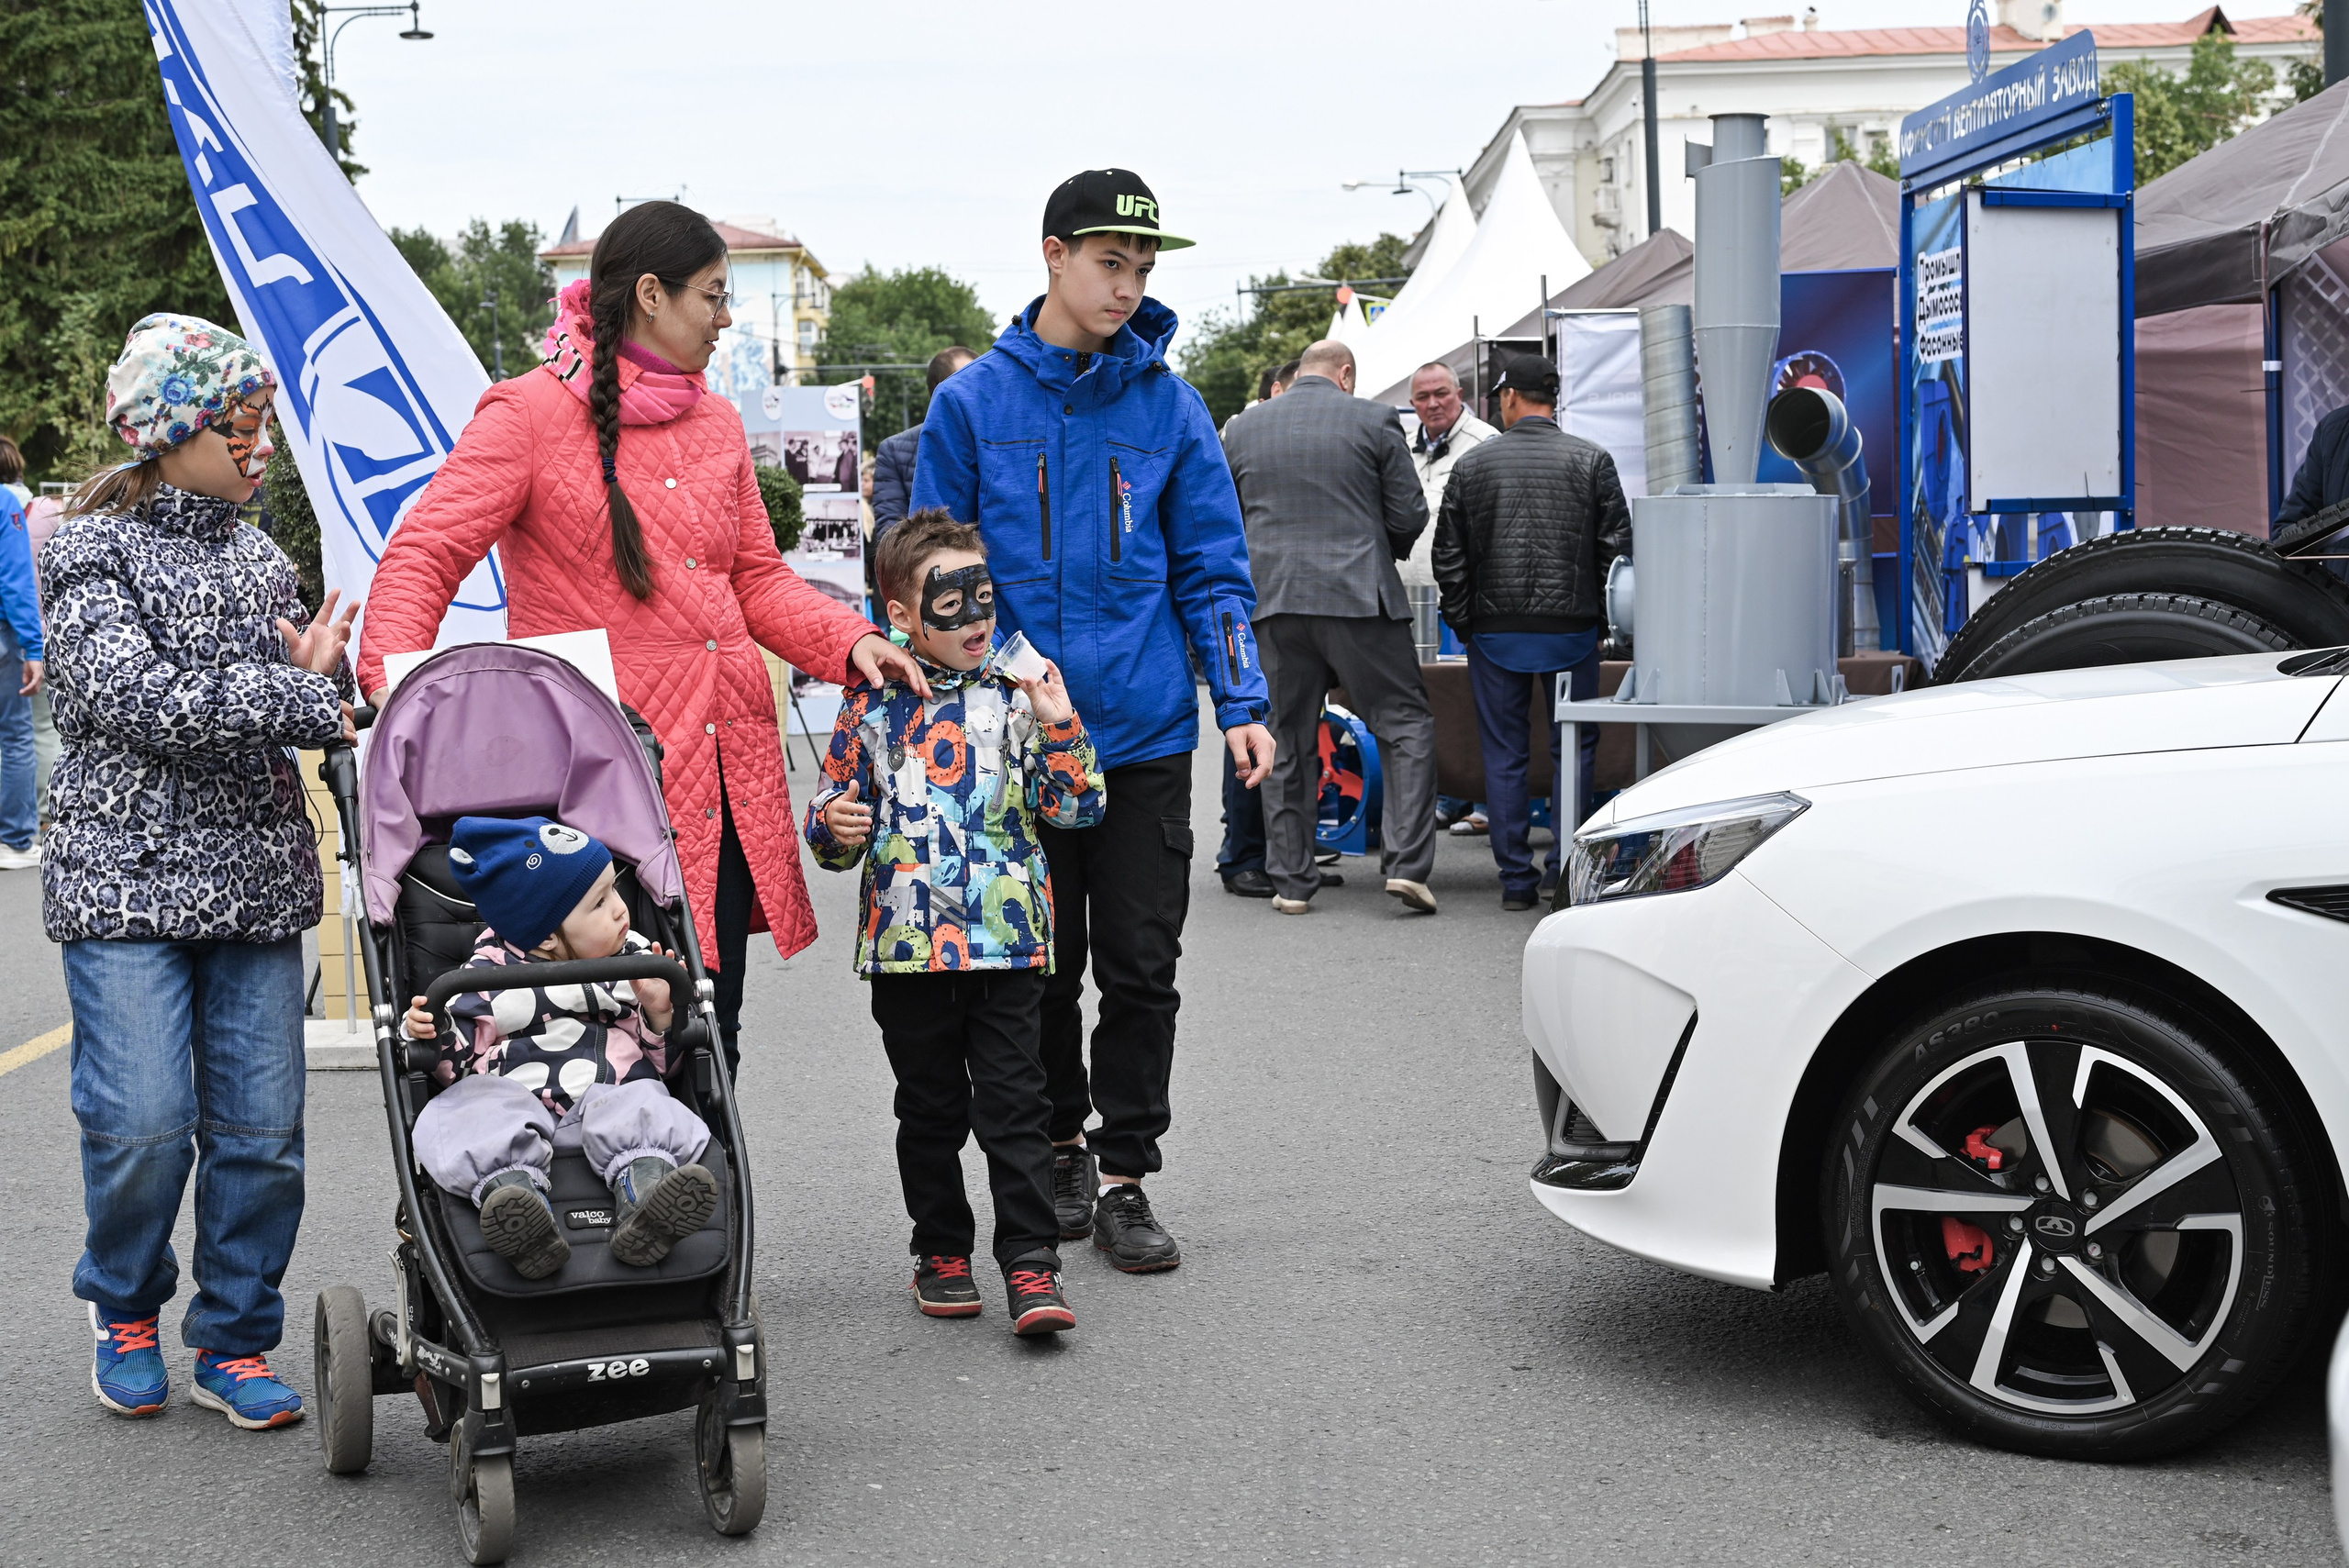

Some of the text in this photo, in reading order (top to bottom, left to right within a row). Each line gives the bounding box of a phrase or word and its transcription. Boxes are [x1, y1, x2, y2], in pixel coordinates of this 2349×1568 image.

[1953, 63, 2046, 139] ВЕНТИЛЯТОРНЫЙ
[2051, 50, 2097, 103] ЗАВОД
[1116, 194, 1159, 223] UFC
[1122, 493, 1134, 533] Columbia
[1237, 632, 1251, 669] Columbia
[1915, 1010, 2000, 1065] AS380
[569, 1210, 605, 1219] valco
[587, 1217, 613, 1225] baby
[587, 1359, 650, 1383] zee
